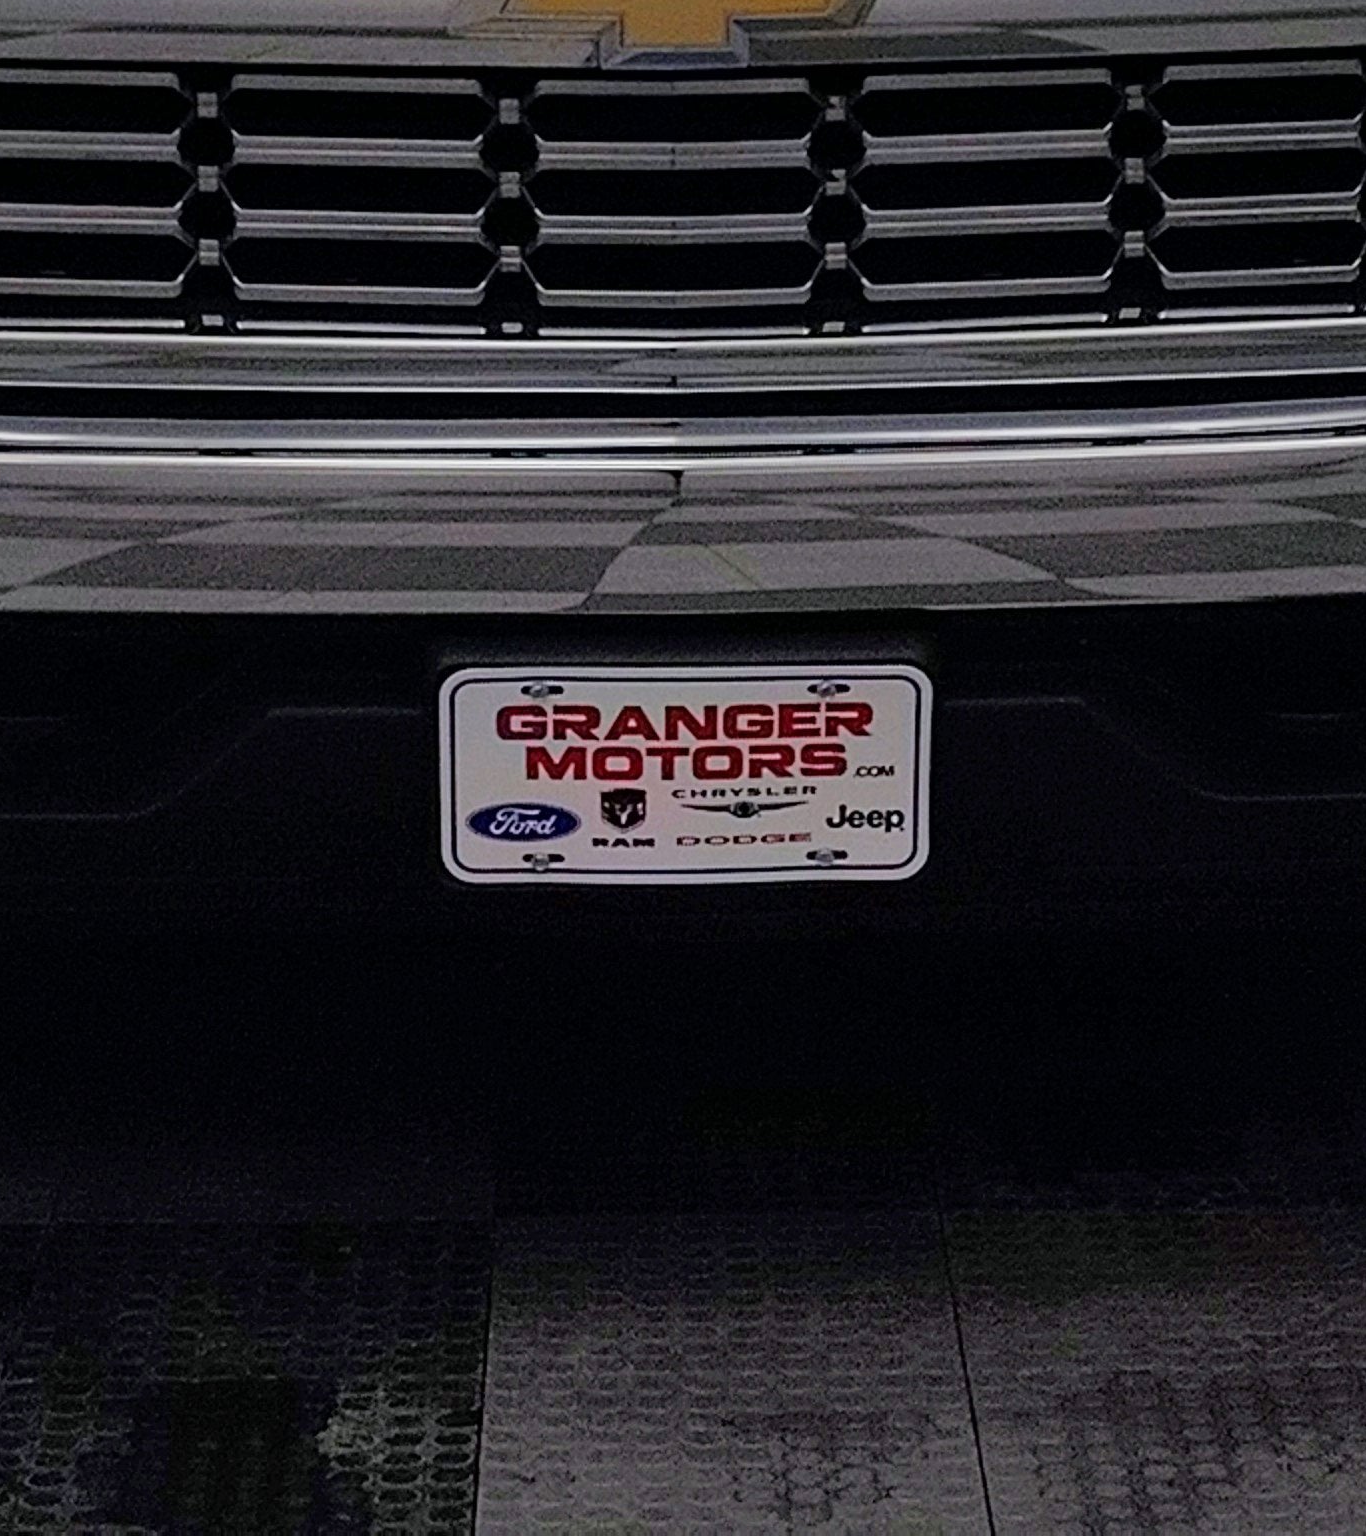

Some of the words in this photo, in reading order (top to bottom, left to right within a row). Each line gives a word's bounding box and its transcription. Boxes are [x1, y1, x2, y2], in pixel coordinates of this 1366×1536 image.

[495, 701, 874, 741] GRANGER
[525, 742, 848, 781] MOTORS
[671, 785, 817, 799] CHRYSLER
[489, 807, 558, 835] Ford
[826, 804, 905, 833] Jeep
[592, 837, 655, 848] RAM
[676, 832, 812, 847] DODGE
